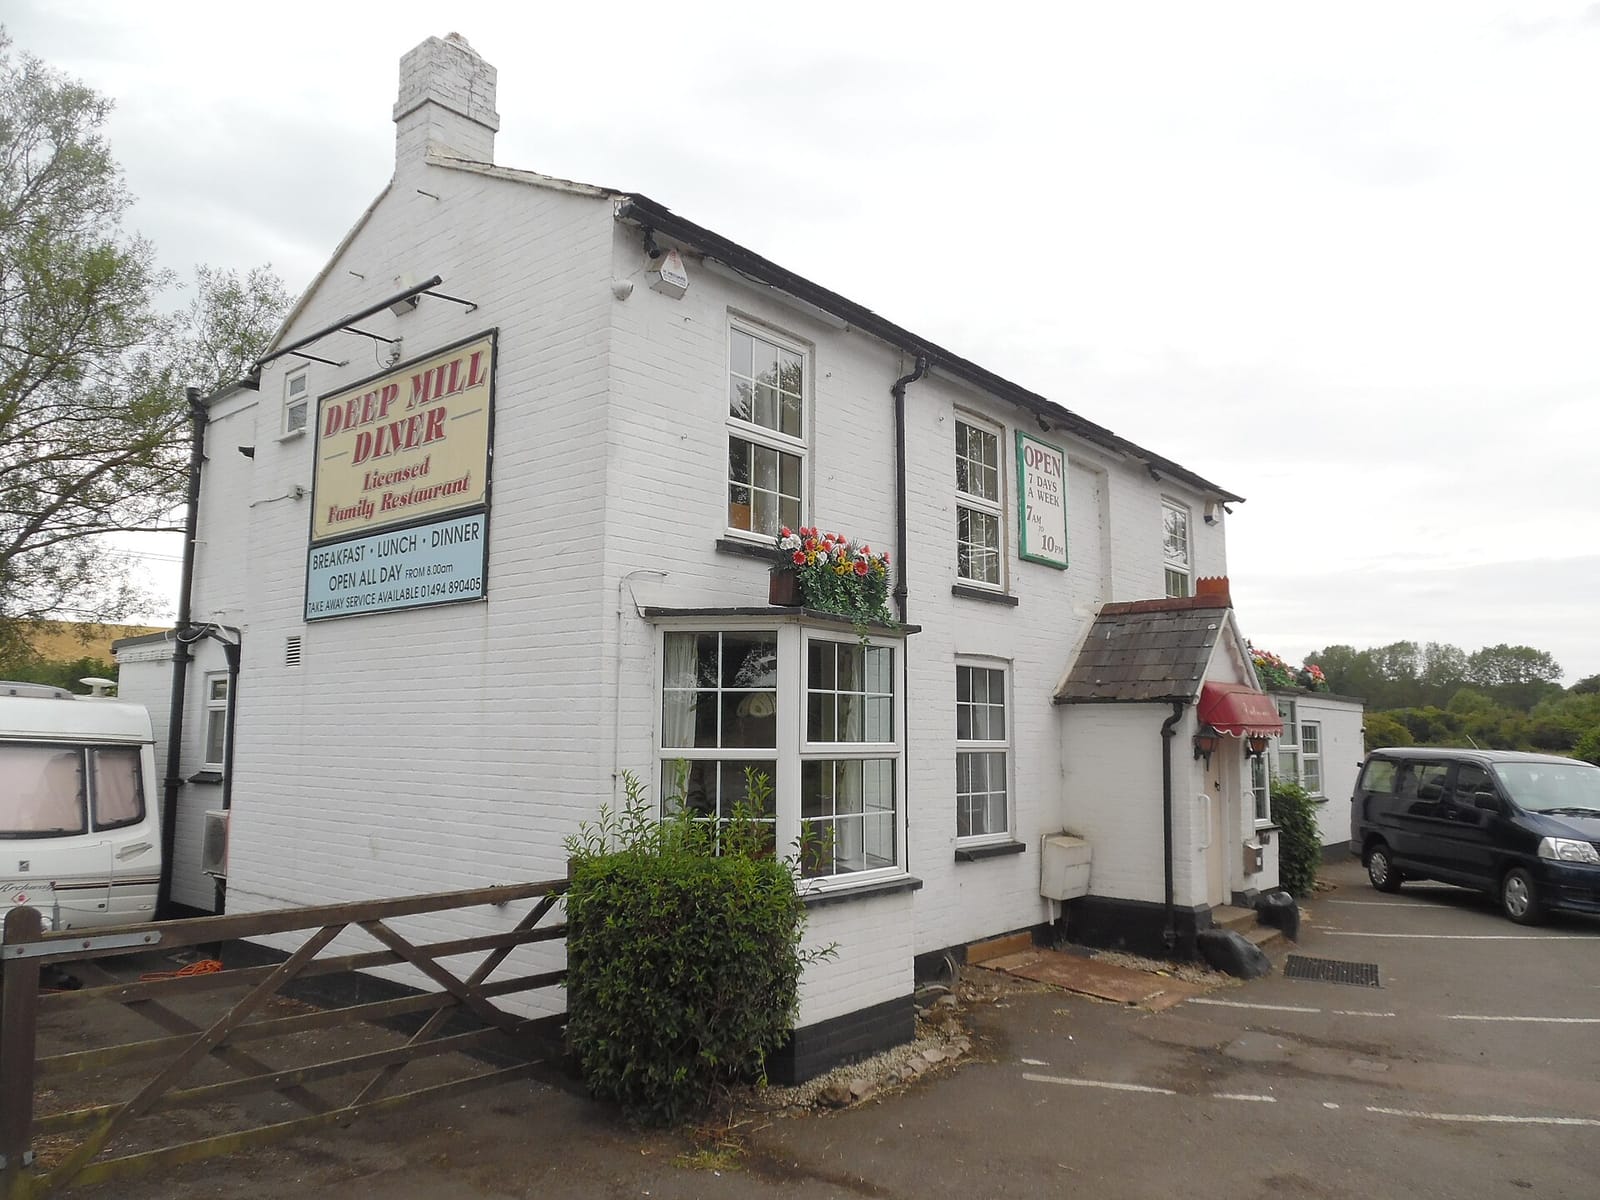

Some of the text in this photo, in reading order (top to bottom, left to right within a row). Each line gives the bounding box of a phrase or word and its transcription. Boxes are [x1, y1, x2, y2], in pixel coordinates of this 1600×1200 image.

[323, 350, 488, 438] DEEP MILL
[352, 406, 448, 466] DINER
[363, 454, 431, 492] Licensed
[1023, 445, 1061, 478] OPEN
[327, 471, 471, 525] Family Restaurant
[1027, 487, 1060, 507] A WEEK
[1028, 473, 1058, 493] 7 DAYS
[313, 522, 480, 571] BREAKFAST LUNCH DINNER
[308, 577, 481, 613] TAKE AWAY SERVICE AVAILABLE 01494 890405
[328, 571, 356, 592] OPEN
[359, 568, 377, 587] ALL
[380, 563, 403, 584] DAY
[405, 566, 425, 579] FROM
